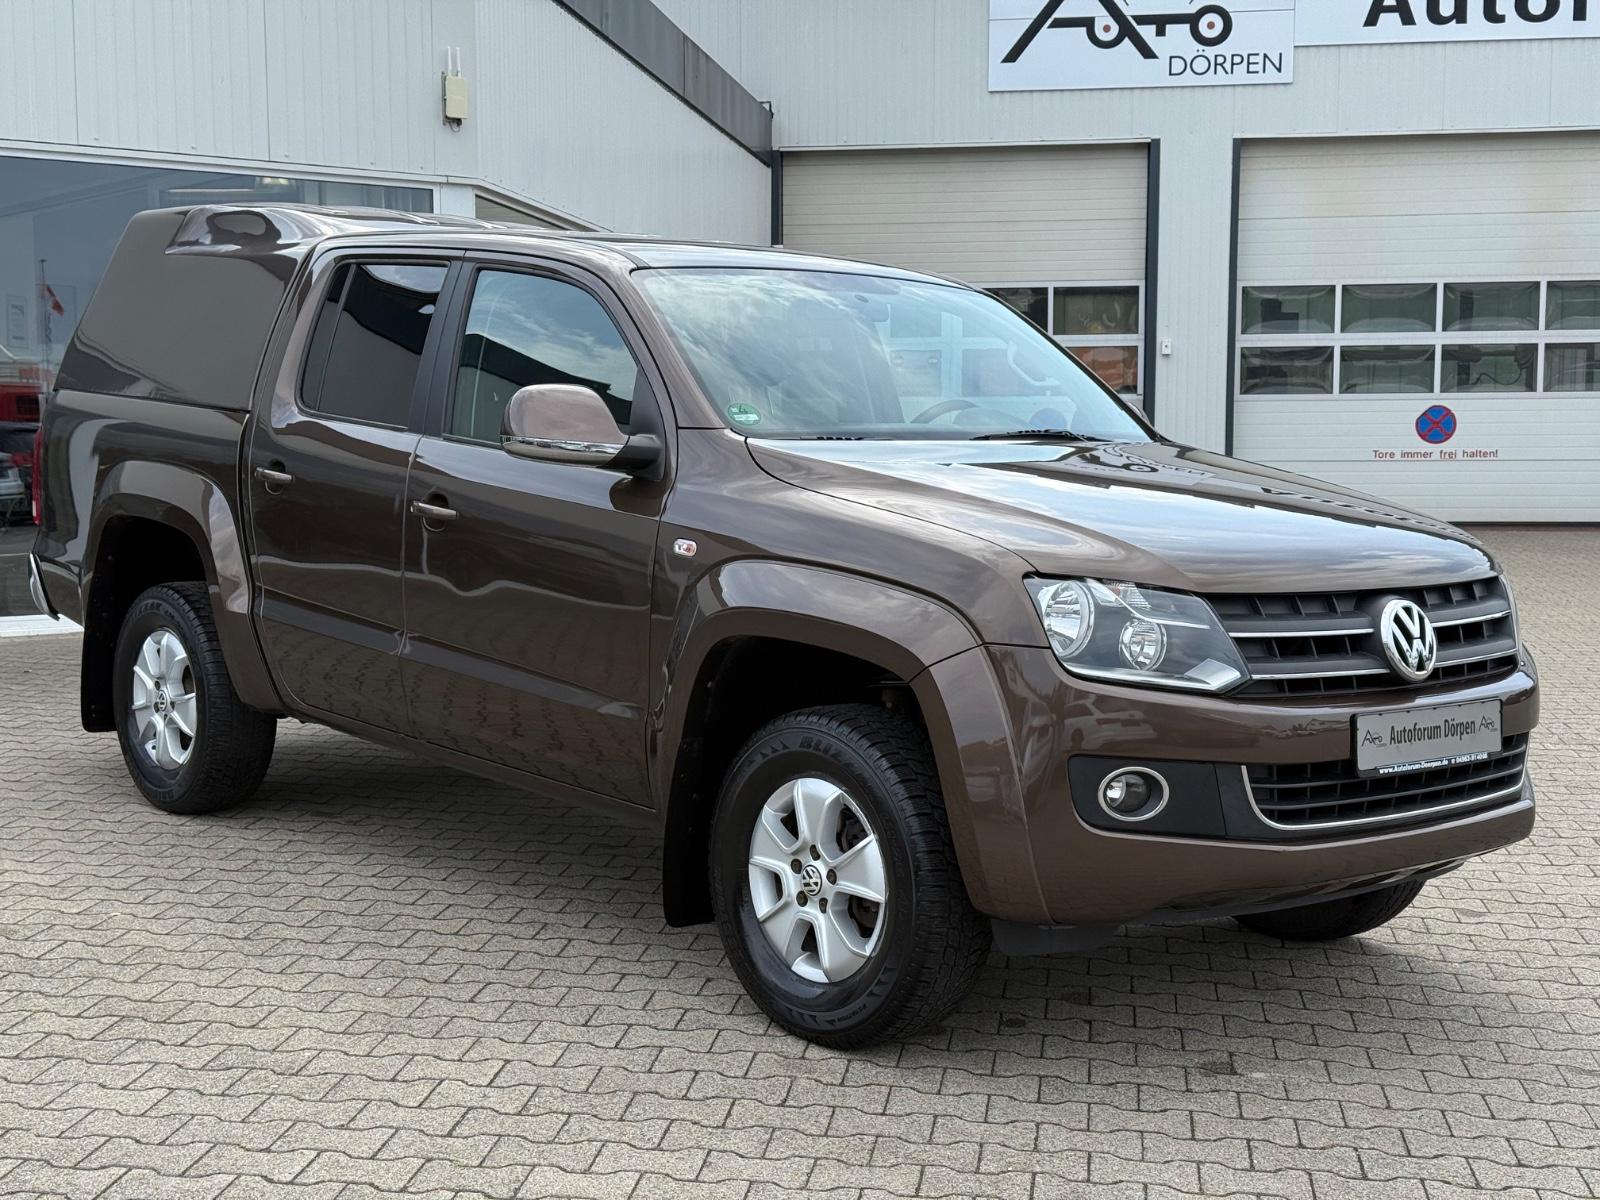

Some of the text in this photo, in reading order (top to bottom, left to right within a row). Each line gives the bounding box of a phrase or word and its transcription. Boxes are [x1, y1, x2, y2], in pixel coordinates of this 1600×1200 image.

[1167, 49, 1283, 77] DÖRPEN
[1373, 449, 1498, 459] Tore immer frei halten!
[1391, 723, 1442, 745] Autoforum
[1444, 718, 1476, 740] Dörpen
